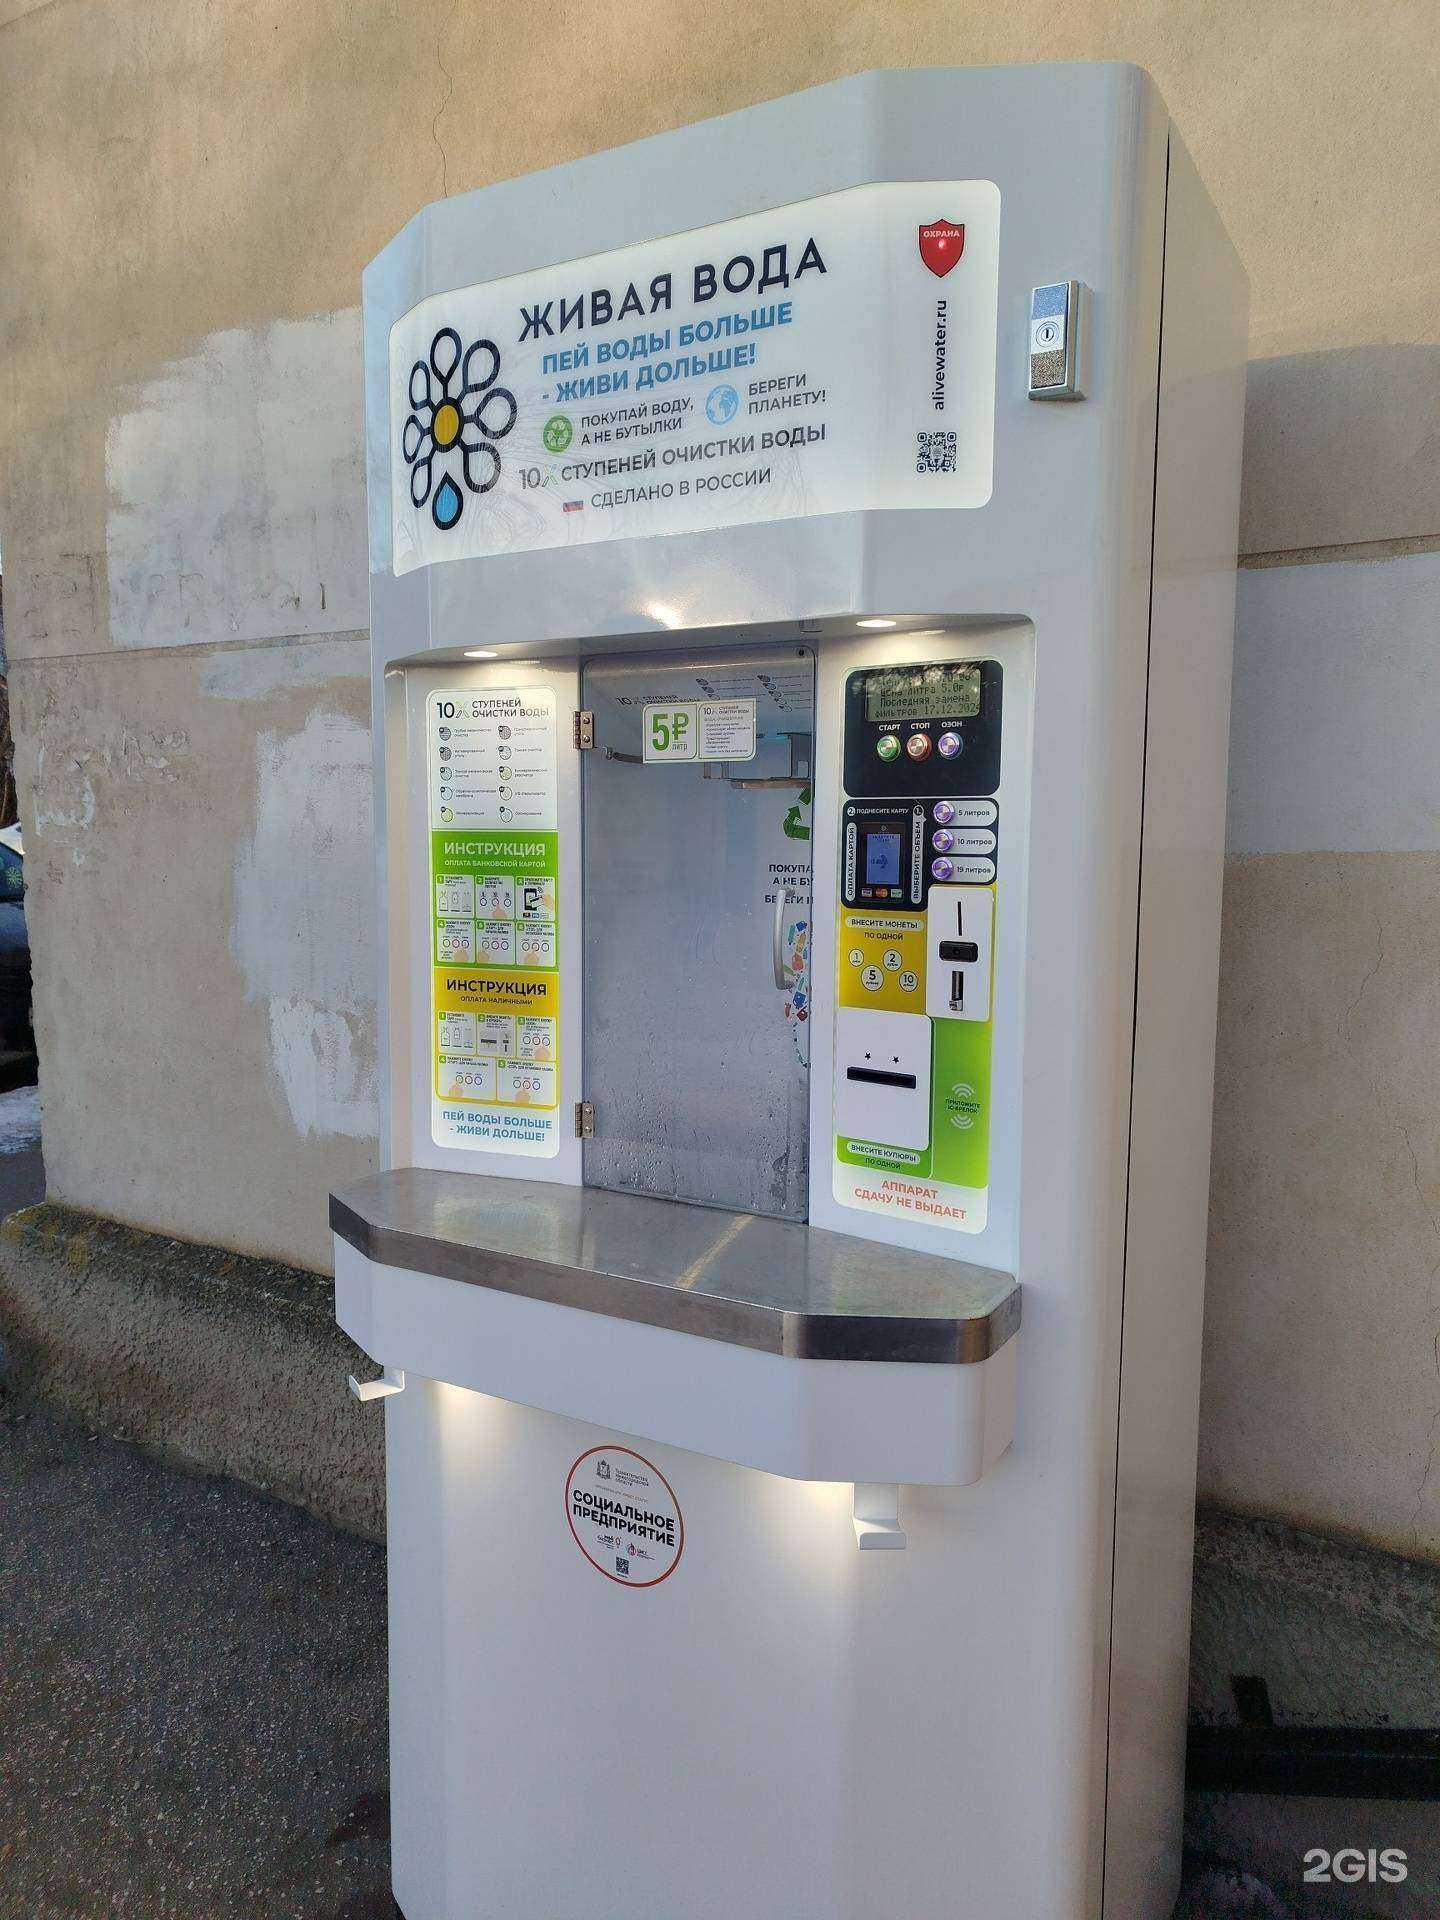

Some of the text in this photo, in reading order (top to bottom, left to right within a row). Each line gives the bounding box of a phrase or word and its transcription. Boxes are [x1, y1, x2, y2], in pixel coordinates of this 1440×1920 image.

[923, 230, 960, 238] ОХРАНА
[518, 237, 828, 342] ЖИВАЯ ВОДА
[542, 301, 793, 375] ПЕЙ ВОДЫ БОЛЬШЕ
[932, 300, 947, 410] alivewater.ru
[556, 369, 629, 403] ЖИВИ
[635, 342, 757, 391] ДОЛЬШЕ!
[748, 373, 807, 396] БЕРЕГИ
[748, 389, 826, 415] ПЛАНЕТУ!
[581, 397, 694, 428] ПОКУПАЙ ВОДУ,
[581, 417, 682, 446] А НЕ БУТЫЛКИ
[518, 423, 826, 490] 10 СТУПЕНЕЙ ОЧИСТКИ ВОДЫ
[591, 467, 771, 509] СДЕЛАНО В РОССИИ
[437, 702, 455, 719] 10
[471, 697, 521, 709] СТУПЕНЕЙ
[703, 707, 712, 716] 10
[880, 697, 930, 708] Последняя
[472, 708, 549, 718] ОЧИСТКИ ВОДЫ
[910, 722, 930, 730] СТОП
[444, 842, 546, 857] ИНСТРУКЦИЯ
[473, 860, 518, 868] БАНКОВСКОЙ
[519, 860, 546, 868] КАРТОЙ
[765, 895, 803, 904] БЕЕГИ
[851, 919, 918, 929] ВНЕСИТЕ МОНЕТЫ
[876, 932, 904, 941] ОДНОЙ
[889, 953, 896, 962] 2
[869, 970, 876, 980] 5
[903, 974, 914, 983] 10
[447, 978, 547, 996] ИНСТРУКЦИЯ
[488, 997, 533, 1006] НАЛИЧНЫМИ
[443, 1110, 552, 1130] ПЕЙ ВОДЫ БОЛЬШЕ
[456, 1124, 490, 1136] ЖИВИ
[493, 1128, 545, 1142] ДОЛЬШЕ!
[851, 1144, 916, 1162] ВНЕСИТЕ КУПЮРЫ
[875, 1159, 901, 1169] ОДНОЙ
[882, 1180, 938, 1199] АППАРАТ
[854, 1188, 966, 1219] СДАЧУ НЕ ВЫДАЕТ
[573, 1489, 675, 1532] СОЦИАЛЬНОЕ
[573, 1504, 675, 1547] ПРЕДПРИЯТИЕ
